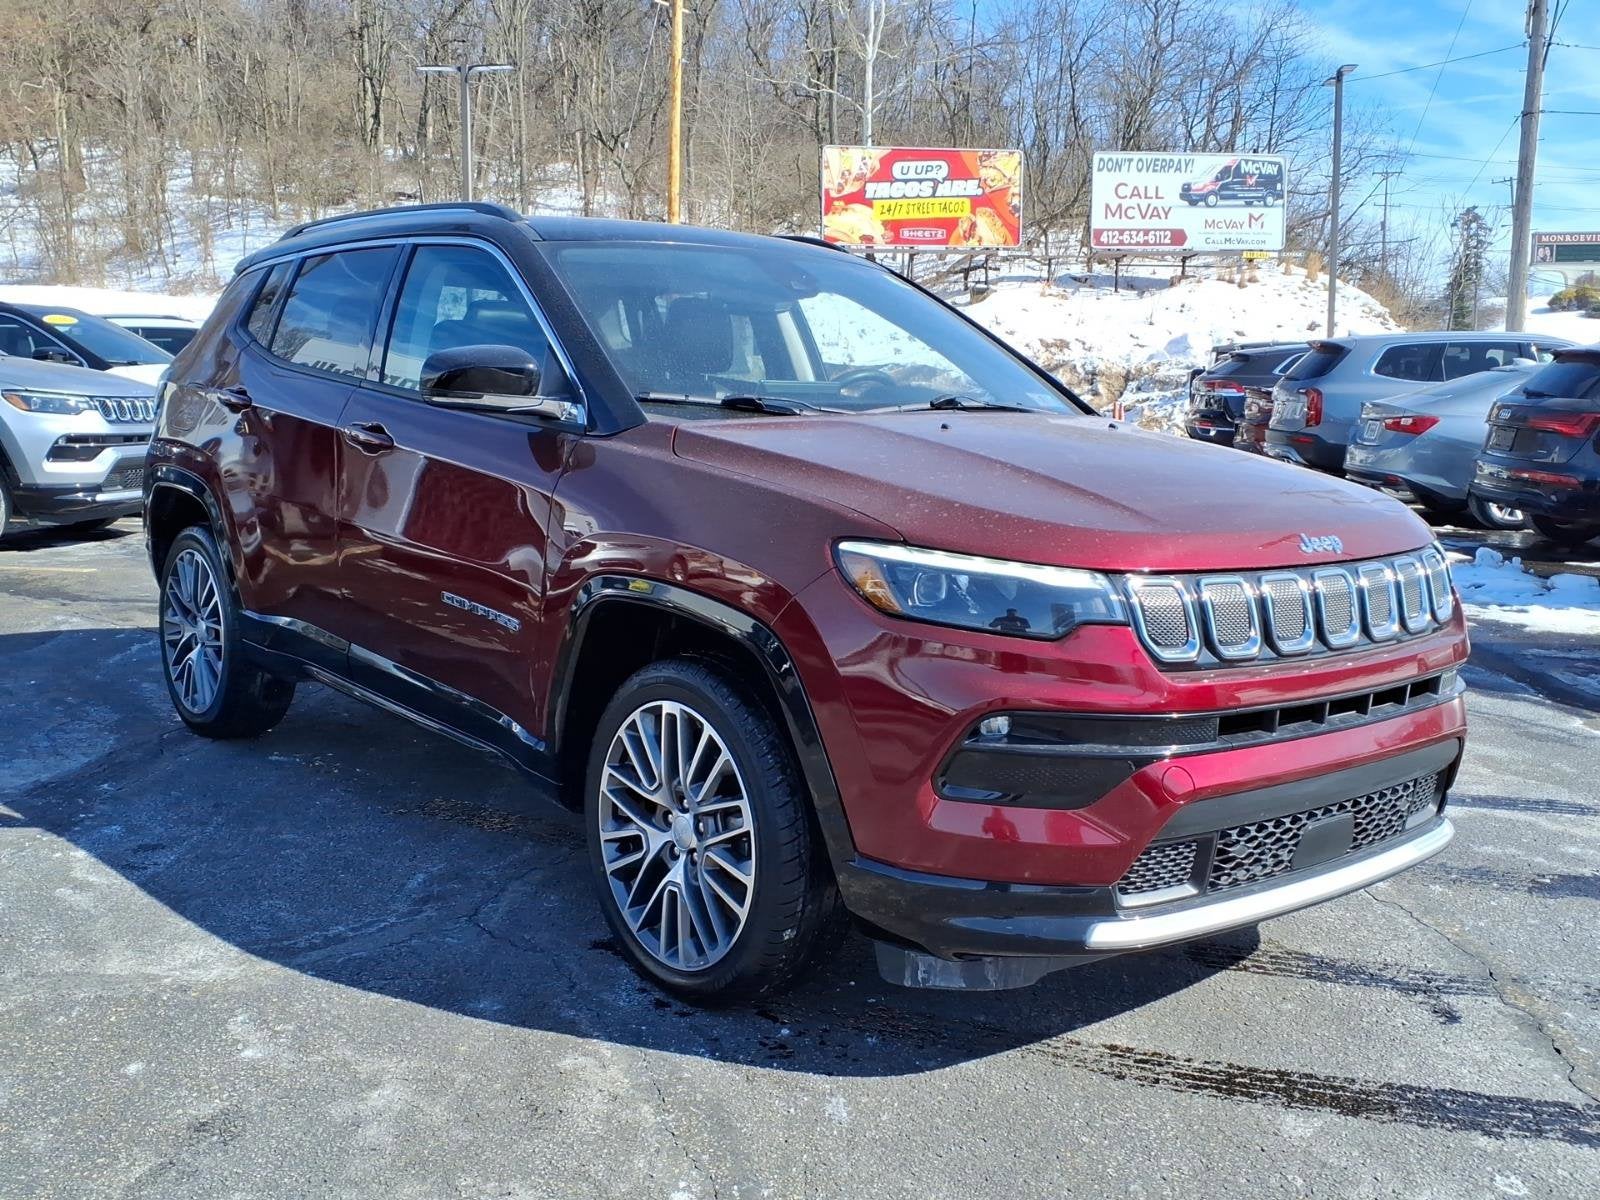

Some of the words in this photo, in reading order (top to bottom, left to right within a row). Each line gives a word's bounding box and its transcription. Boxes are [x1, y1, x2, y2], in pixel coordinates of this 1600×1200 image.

[900, 164, 908, 175] U
[914, 164, 943, 175] UP?
[1097, 158, 1133, 173] DON'T
[1136, 158, 1195, 174] OVERPAY!
[865, 181, 934, 199] TACOS
[935, 180, 984, 198] ARE.
[879, 204, 903, 216] 24/7
[905, 202, 937, 215] STREET
[938, 200, 966, 214] TACOS
[902, 229, 944, 239] SHEETZ
[1100, 230, 1172, 245] 412-634-6112
[1299, 532, 1344, 555] Jeep
